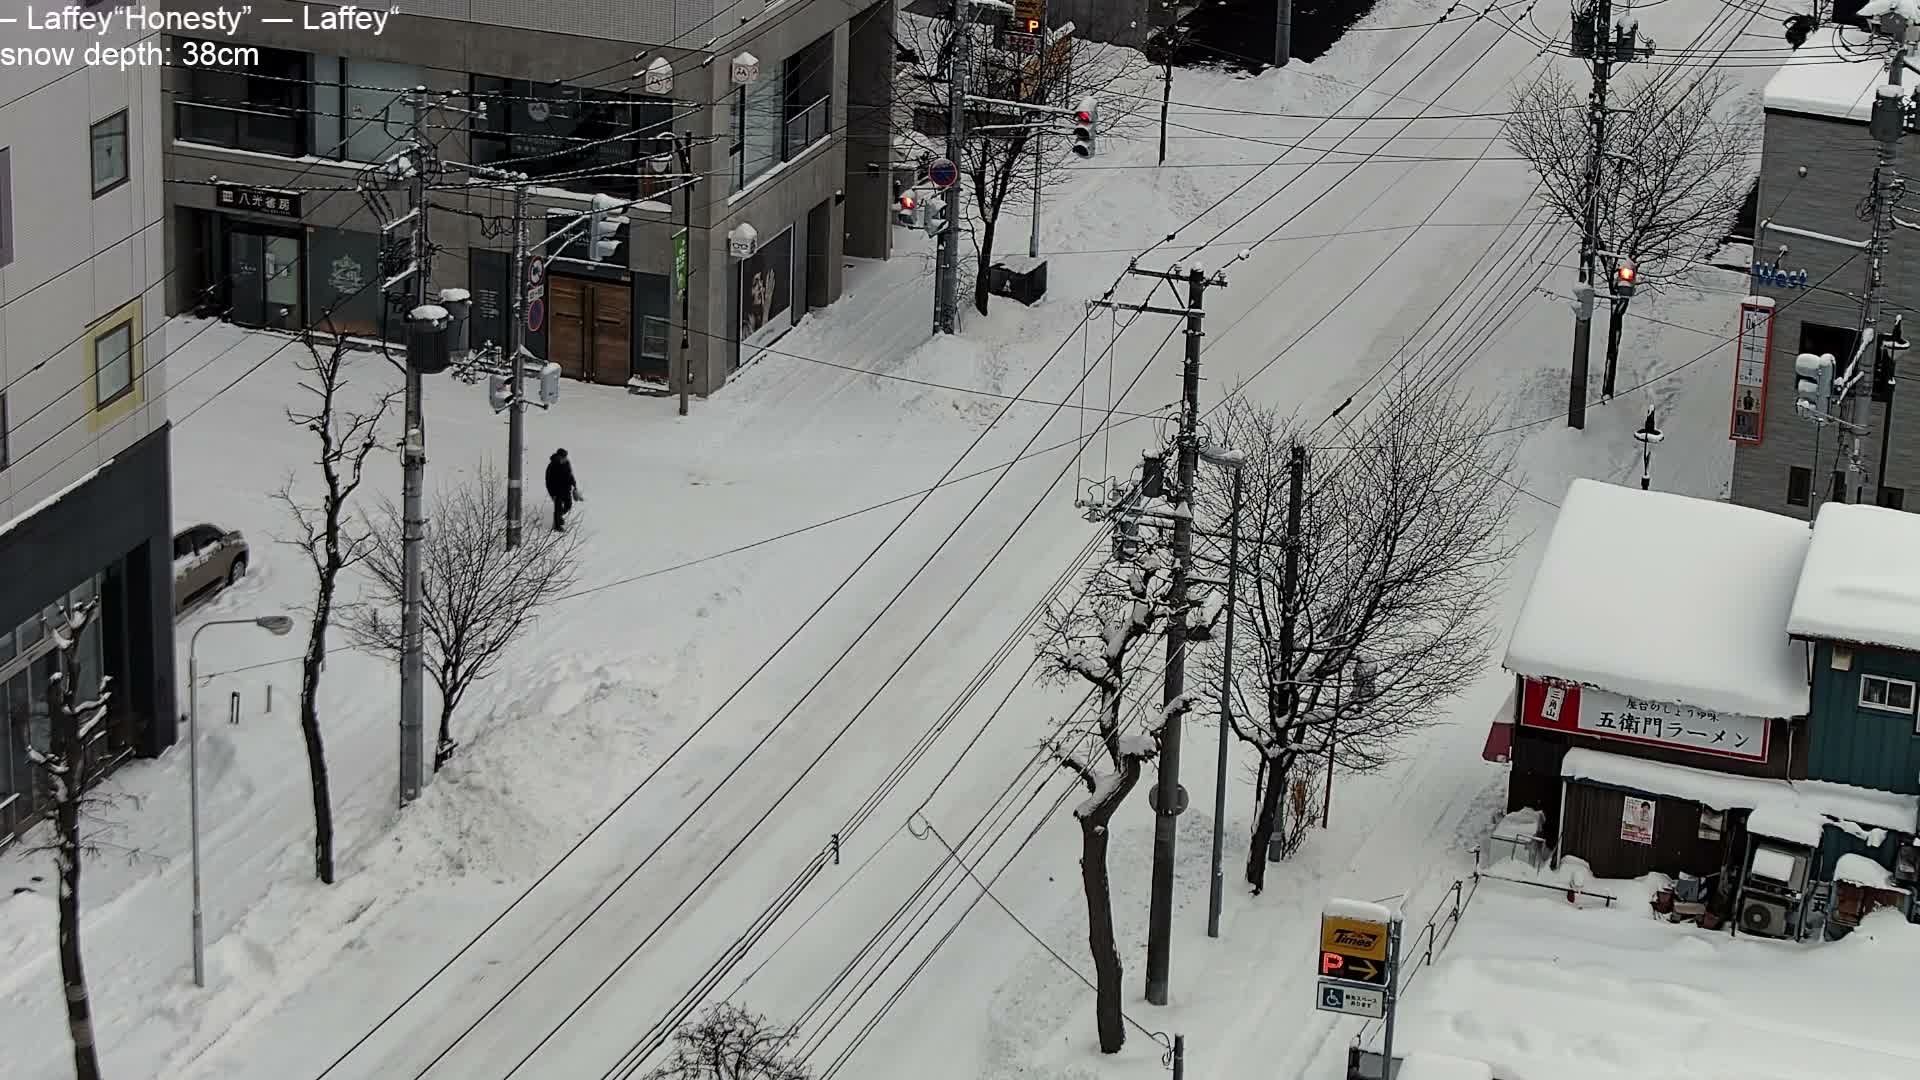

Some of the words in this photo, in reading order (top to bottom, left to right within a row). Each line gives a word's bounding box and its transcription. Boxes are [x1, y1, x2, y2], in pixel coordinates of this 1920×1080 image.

[1029, 20, 1039, 33] P
[1753, 262, 1807, 288] West
[1545, 690, 1561, 718] 三角山
[1595, 711, 1750, 748] 五衛門ラーメン
[1334, 928, 1375, 948] Times
[1323, 952, 1344, 974] P
[1345, 994, 1377, 1004] スペース
